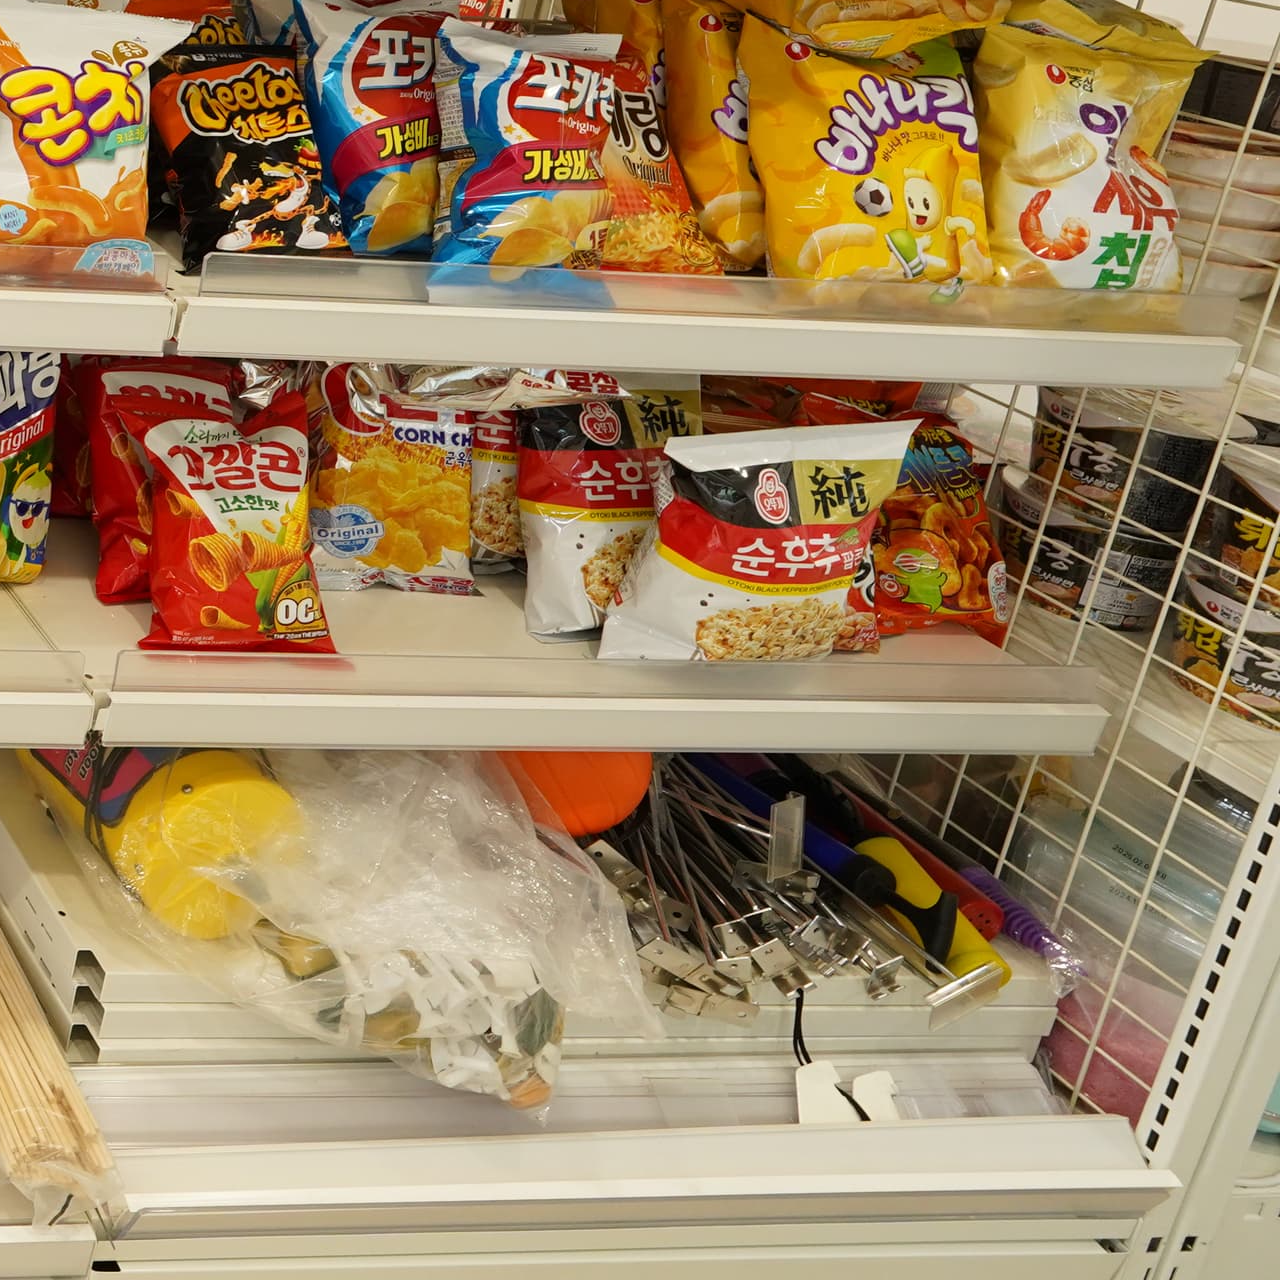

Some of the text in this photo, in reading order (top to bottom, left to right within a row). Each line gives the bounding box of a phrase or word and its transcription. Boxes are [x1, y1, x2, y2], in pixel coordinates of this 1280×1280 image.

[566, 116, 601, 135] Original
[523, 147, 588, 183] 가성비
[394, 426, 446, 445] CORN
[213, 494, 281, 514] 고소한맛
[316, 522, 379, 541] Original
[730, 536, 840, 578] 순후추
